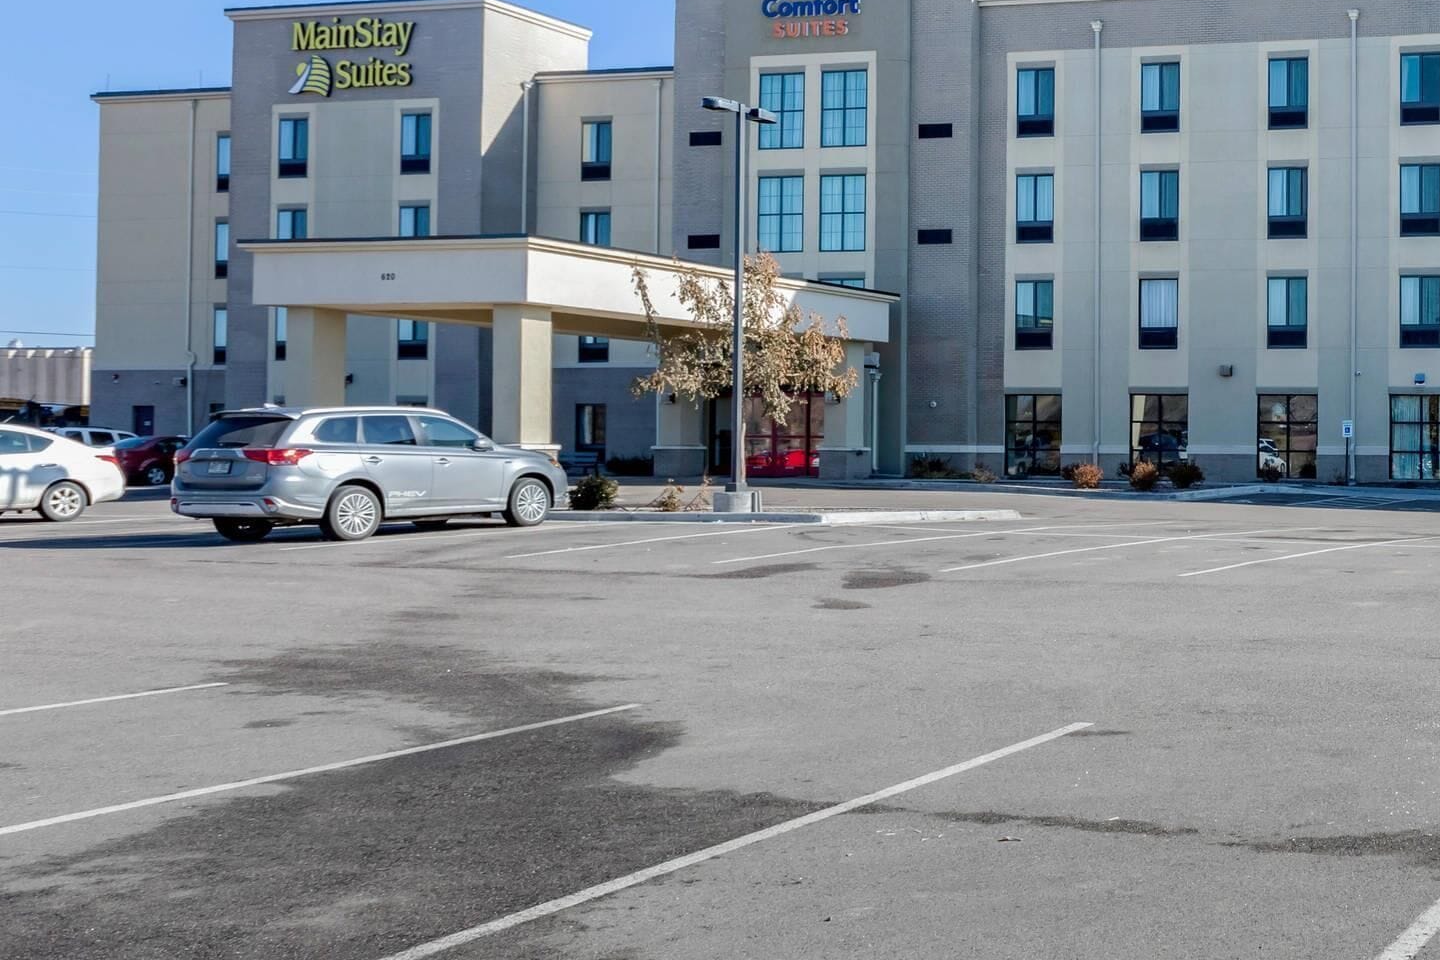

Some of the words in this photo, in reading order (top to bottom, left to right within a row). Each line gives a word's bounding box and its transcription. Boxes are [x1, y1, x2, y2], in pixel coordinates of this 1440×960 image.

[291, 17, 414, 56] MainStay
[773, 19, 849, 38] SUITES
[335, 57, 412, 89] Suites
